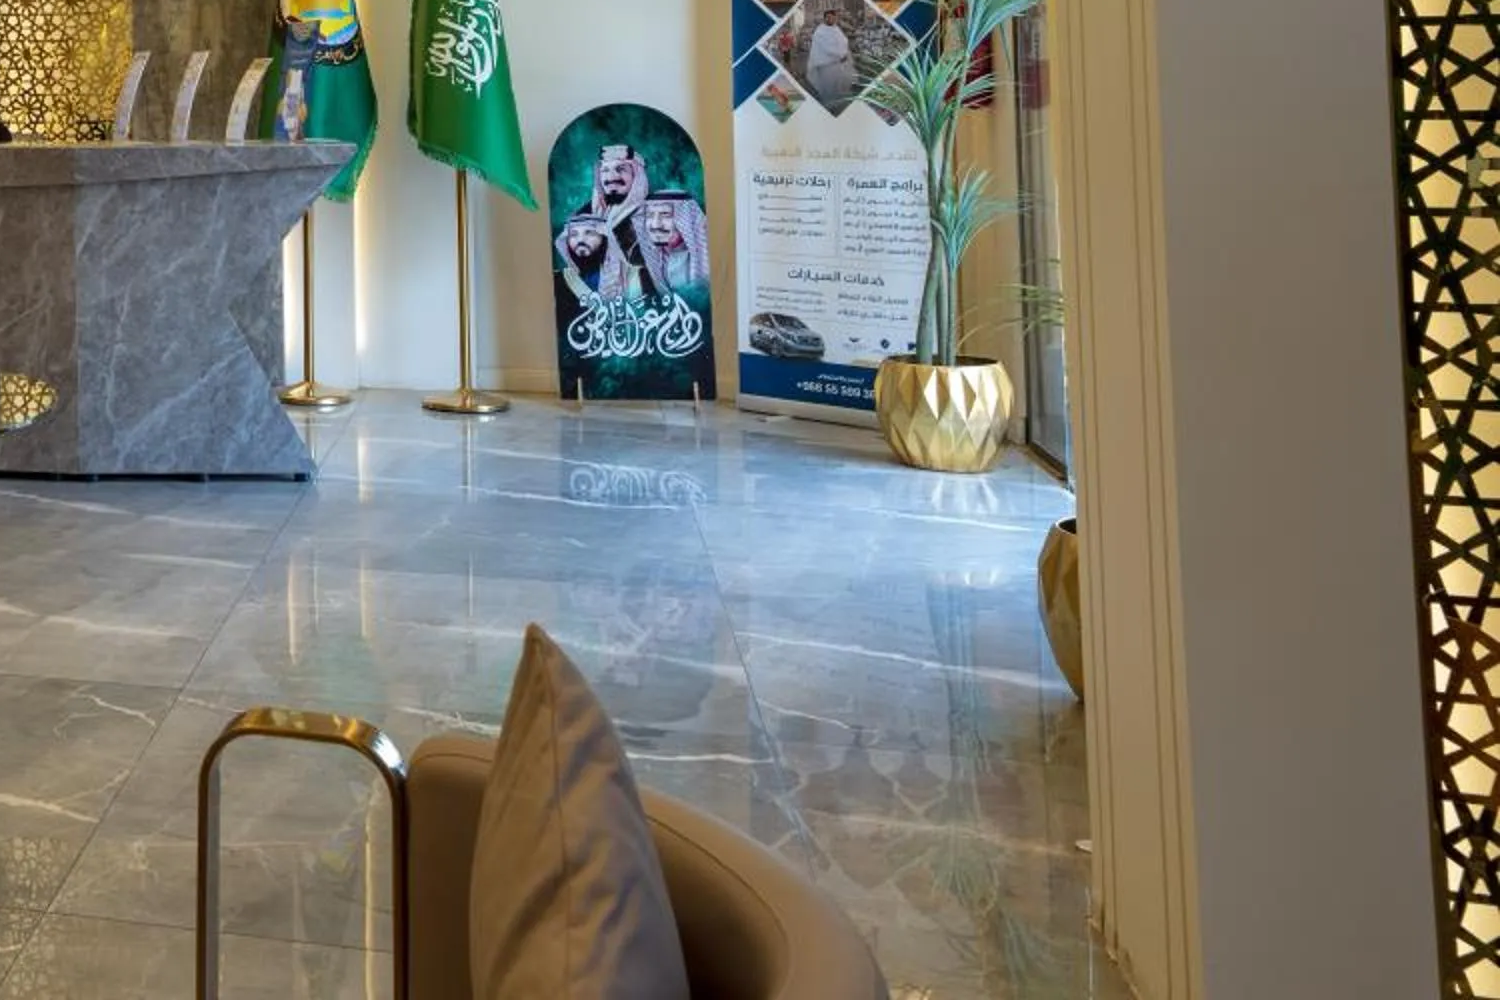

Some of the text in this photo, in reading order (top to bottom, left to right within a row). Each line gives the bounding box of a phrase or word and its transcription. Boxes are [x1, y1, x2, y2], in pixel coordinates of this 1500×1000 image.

[753, 173, 831, 189] رحلات ترفيهية
[846, 176, 924, 193] برامج العمرة
[787, 267, 885, 287] خدمات السيارات
